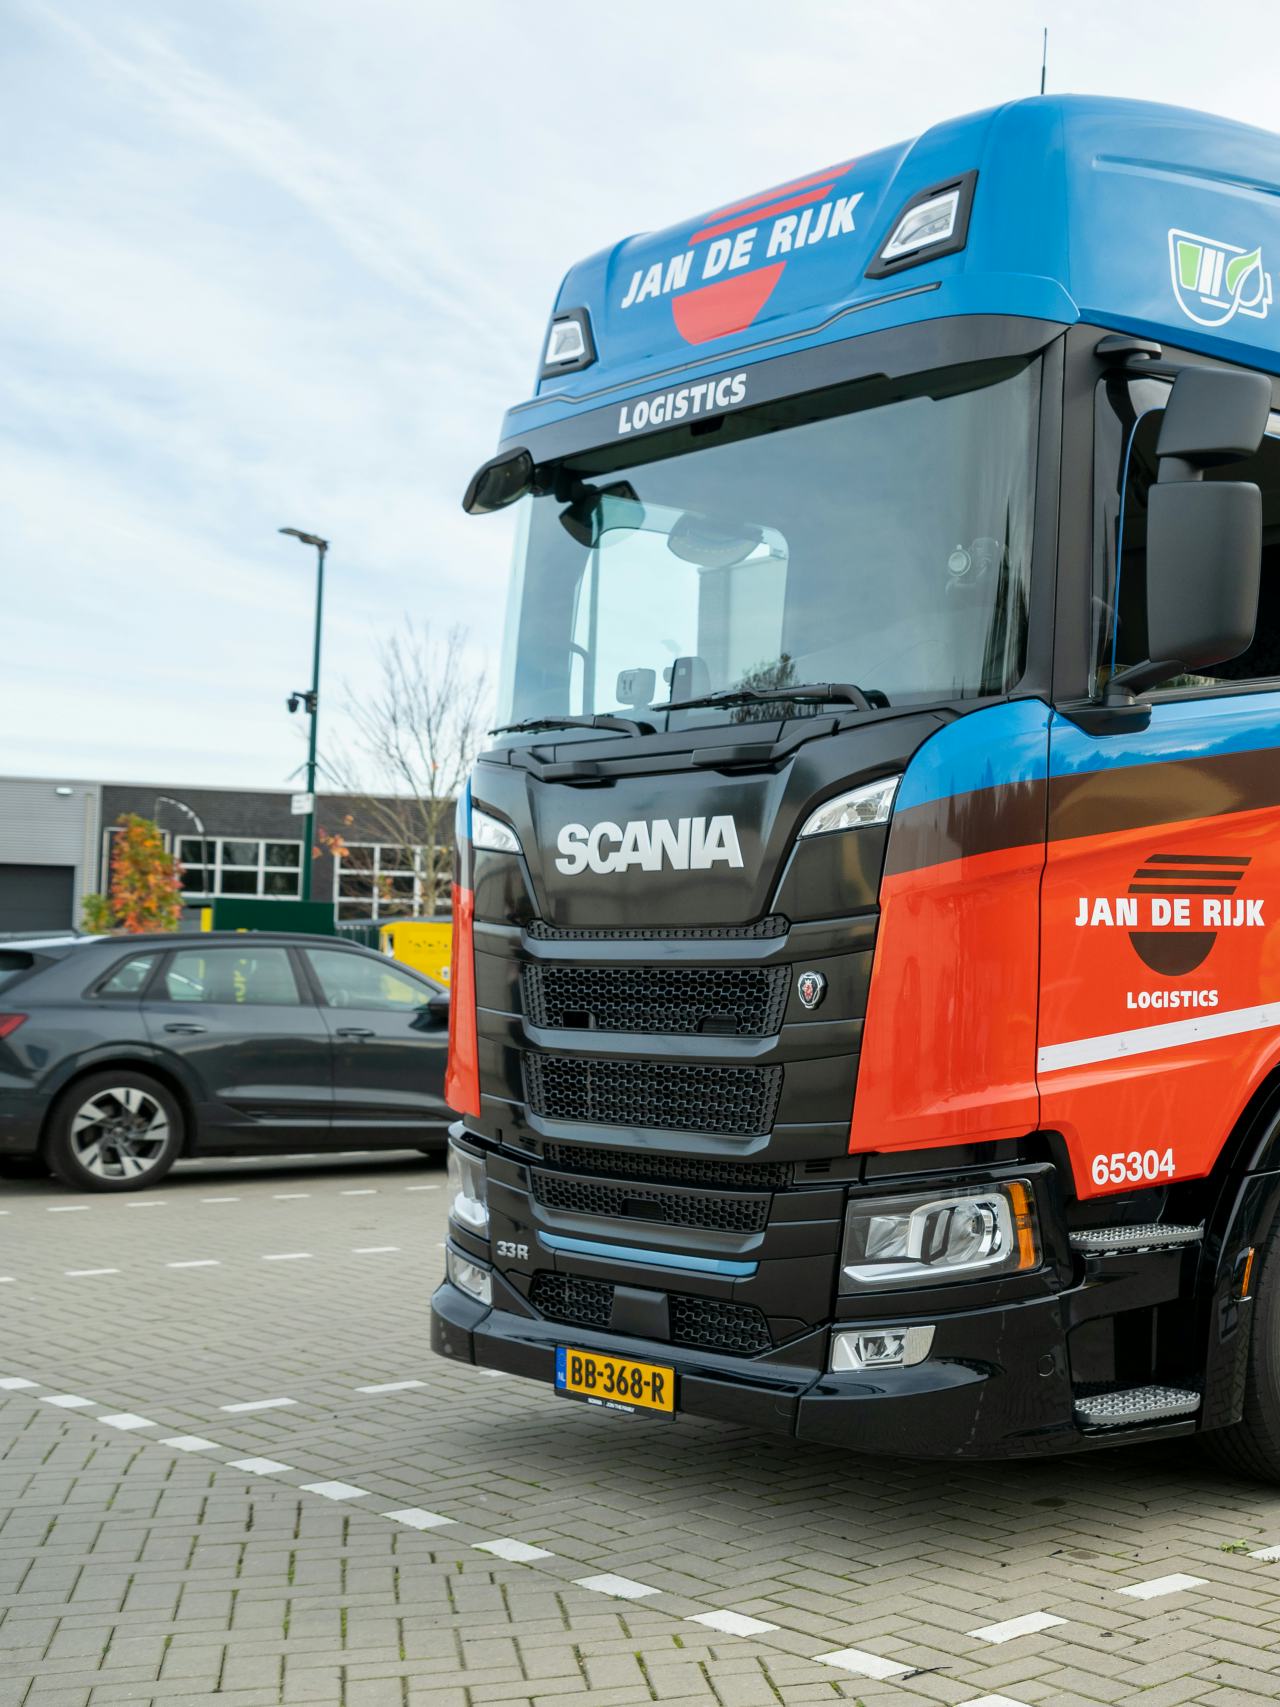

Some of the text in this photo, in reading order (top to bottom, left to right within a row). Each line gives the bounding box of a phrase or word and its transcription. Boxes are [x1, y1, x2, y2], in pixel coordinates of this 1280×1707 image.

[621, 192, 864, 309] JAN DE RIJK
[618, 373, 747, 434] LOGISTICS
[555, 815, 744, 876] SCANIA
[1075, 897, 1265, 927] JAN DE RIJK
[1127, 990, 1218, 1009] LOGISTICS
[1092, 1148, 1175, 1185] 65304
[497, 1240, 529, 1260] 33R
[571, 1356, 665, 1404] BB-368-R
